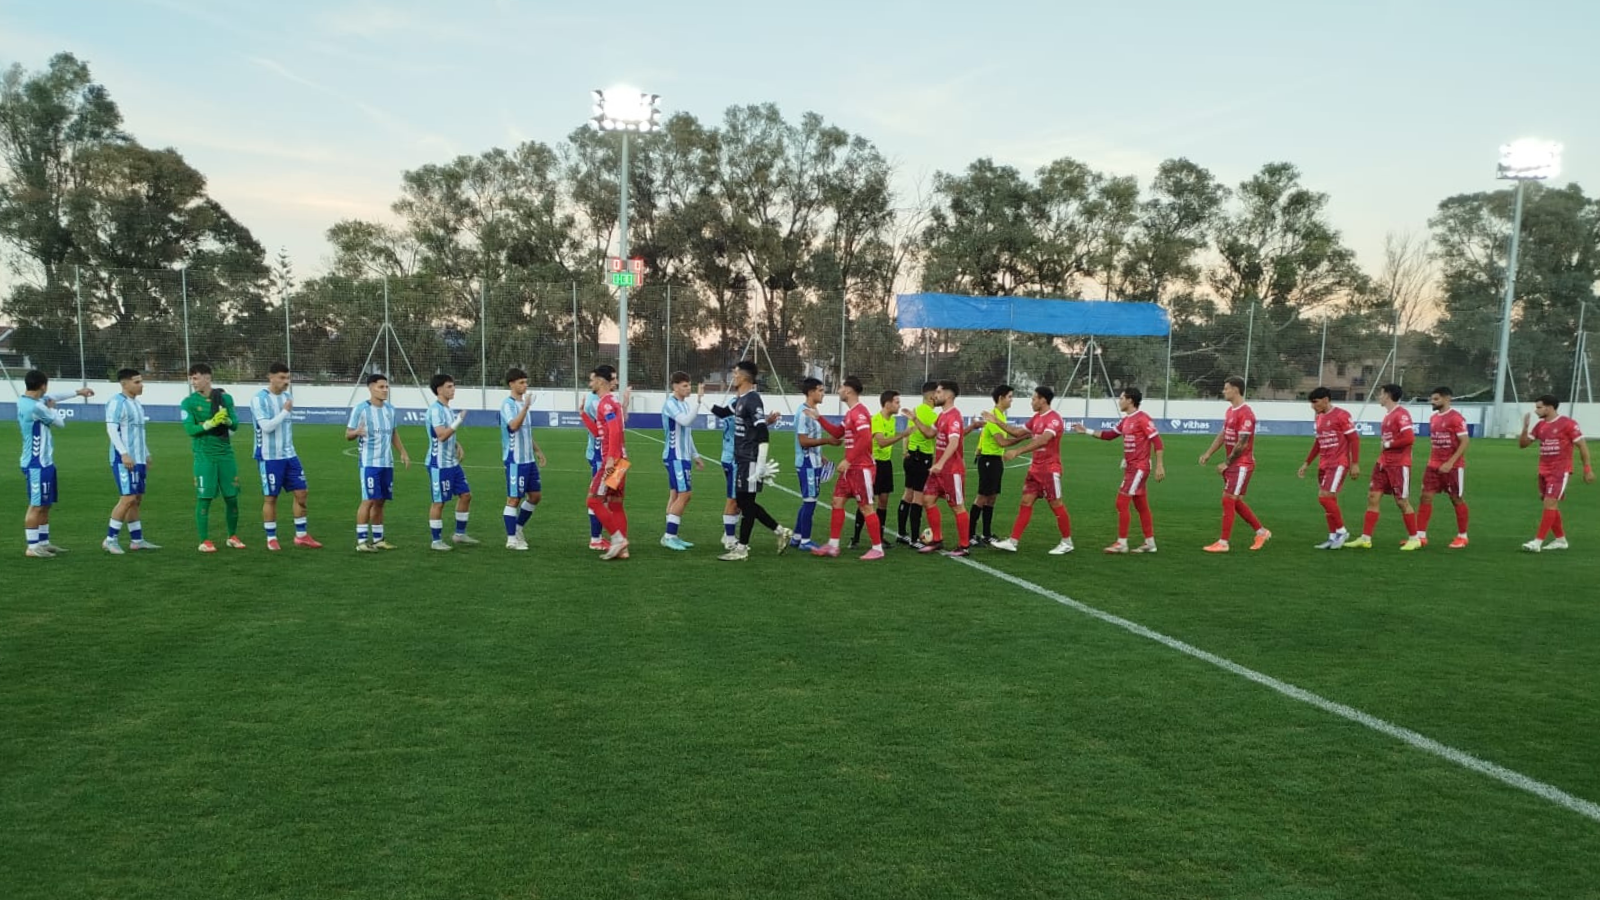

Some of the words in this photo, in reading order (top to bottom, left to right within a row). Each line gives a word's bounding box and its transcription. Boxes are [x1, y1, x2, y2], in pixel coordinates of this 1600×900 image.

[1182, 420, 1210, 429] vithas
[199, 476, 204, 487] 1
[268, 473, 276, 485] 9
[367, 476, 374, 488] 8
[518, 476, 525, 487] 6
[441, 479, 450, 492] 19
